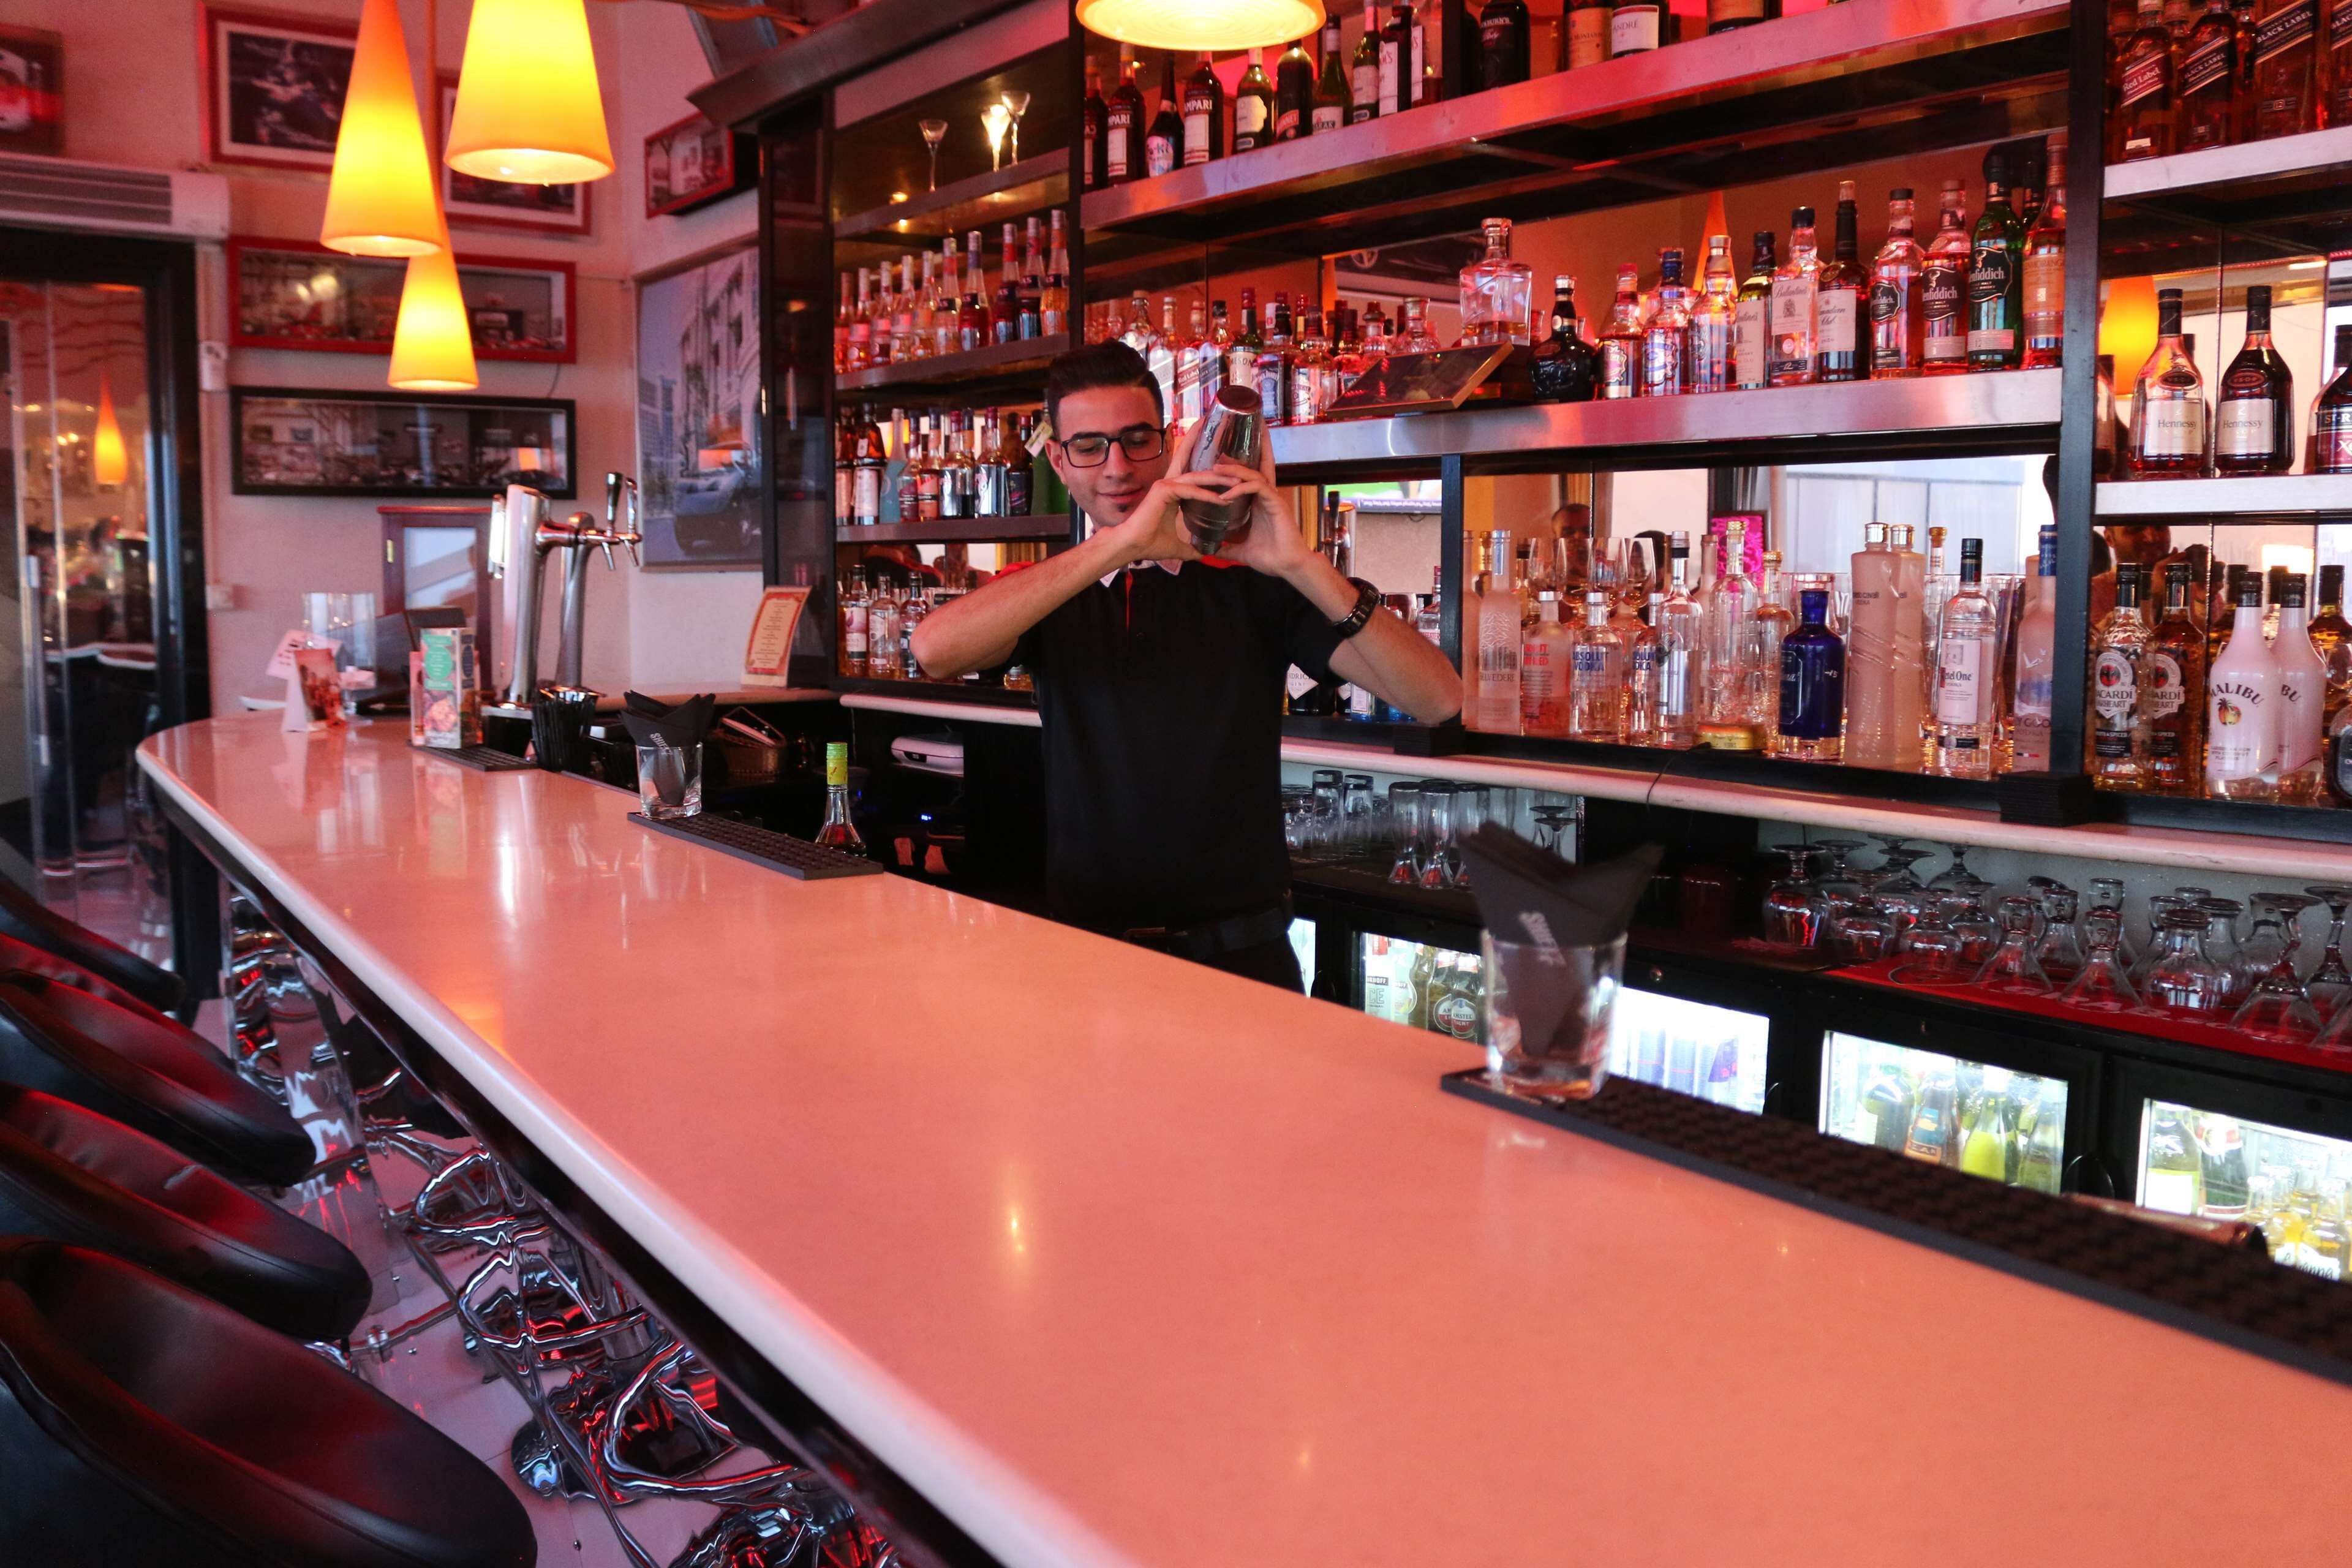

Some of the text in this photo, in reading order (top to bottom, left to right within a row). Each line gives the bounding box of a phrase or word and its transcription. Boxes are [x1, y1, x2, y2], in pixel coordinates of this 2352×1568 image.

[2256, 11, 2313, 43] BLACK LABEL
[2122, 67, 2161, 91] Red Label
[2224, 419, 2264, 429] Hennessy
[1956, 671, 1972, 680] One
